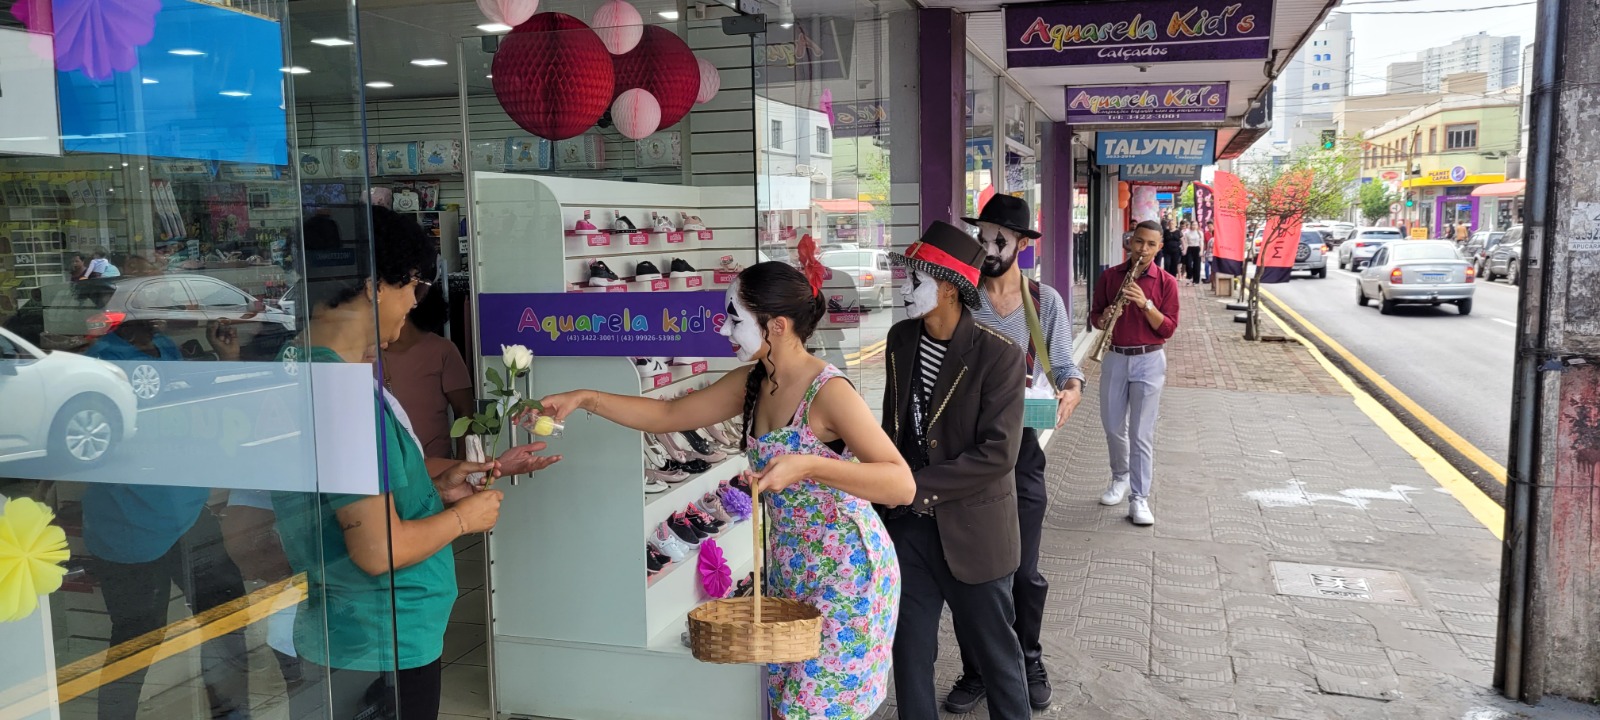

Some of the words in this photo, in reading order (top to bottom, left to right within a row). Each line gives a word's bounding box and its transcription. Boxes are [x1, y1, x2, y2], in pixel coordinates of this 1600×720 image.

[1020, 13, 1158, 52] Aquarela
[1166, 3, 1255, 38] Kid's
[1097, 45, 1168, 61] Calçados
[1069, 90, 1158, 114] Aquarela
[1163, 86, 1220, 107] Kid's
[1104, 139, 1207, 155] TALYNNE
[1126, 164, 1196, 175] TALYNNE
[517, 306, 649, 341] Aquarela
[662, 305, 727, 334] kid's
[566, 334, 580, 343] (43)
[581, 334, 615, 342] 3422-3001
[620, 334, 634, 343] (43)
[635, 334, 675, 342] 99926-5398
